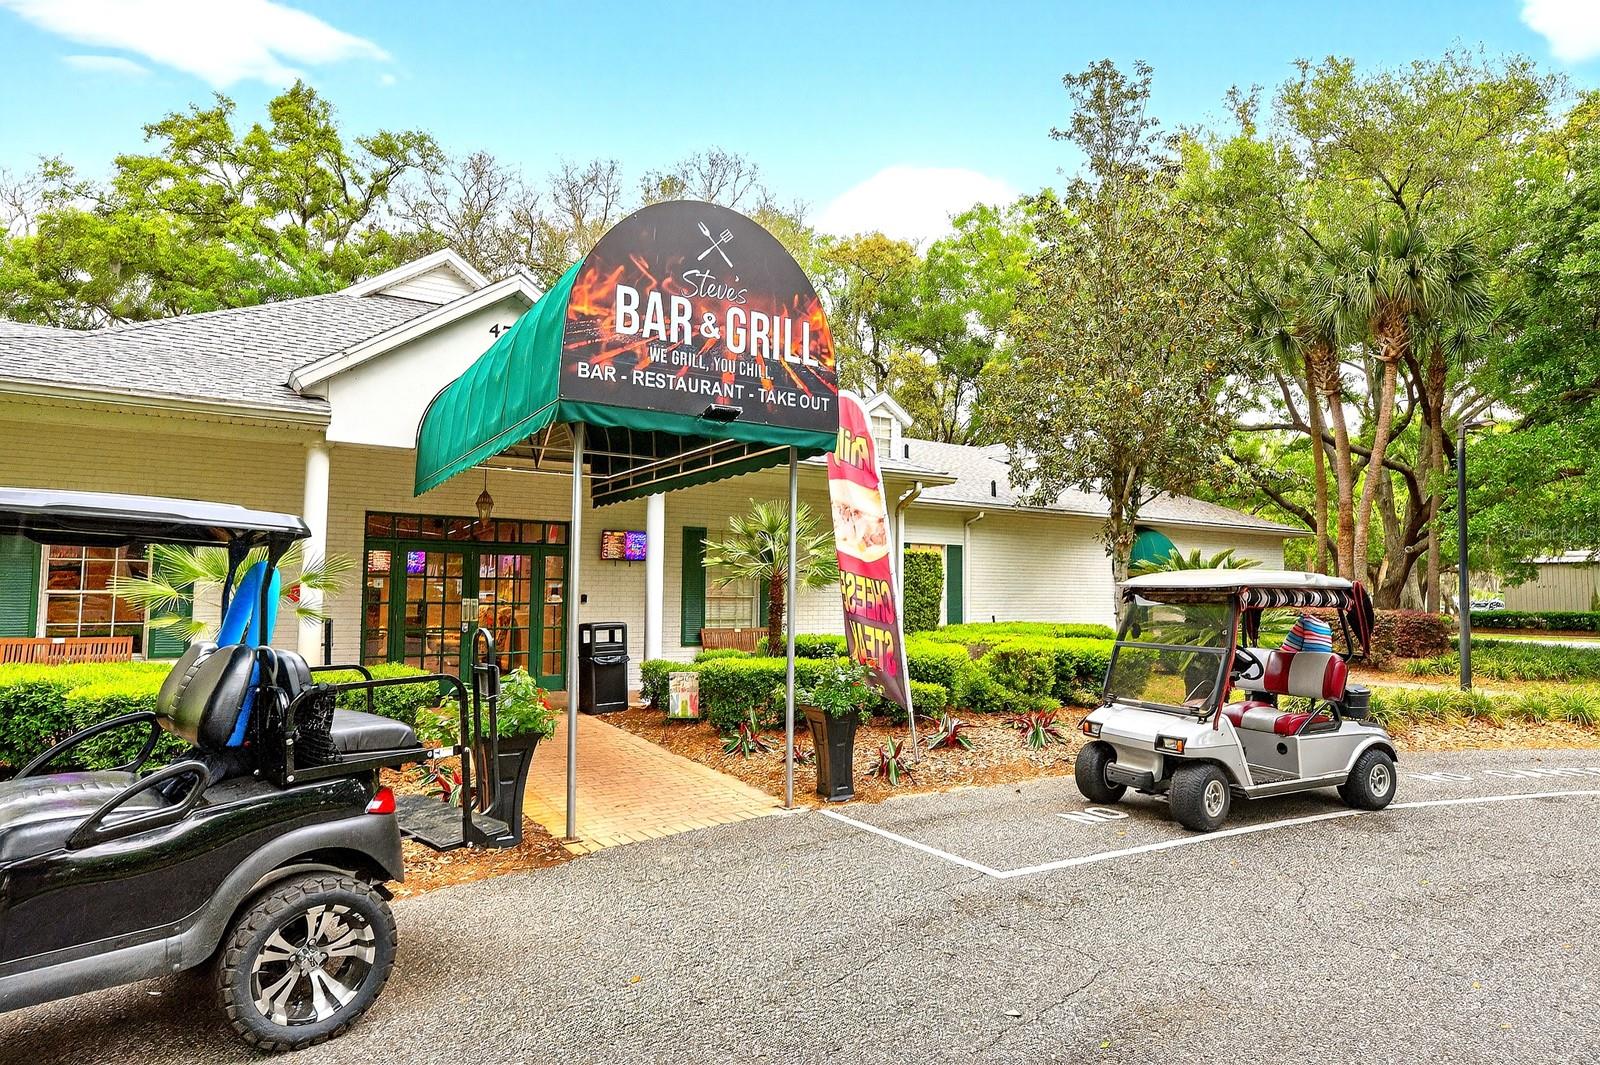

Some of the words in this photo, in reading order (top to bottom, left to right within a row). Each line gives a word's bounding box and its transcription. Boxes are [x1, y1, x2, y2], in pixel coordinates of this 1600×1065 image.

[681, 269, 748, 304] Steve's
[616, 284, 692, 346] BAR
[700, 312, 721, 340] &
[726, 306, 819, 367] GRILL
[650, 345, 668, 364] WE
[672, 350, 709, 372] GRILL,
[714, 356, 736, 373] YOU
[740, 360, 775, 381] CHILL.
[577, 361, 617, 383] BAR
[632, 369, 745, 400] RESTAURANT
[757, 387, 797, 407] TAKE
[800, 394, 830, 412] OUT
[1055, 807, 1129, 825] NO
